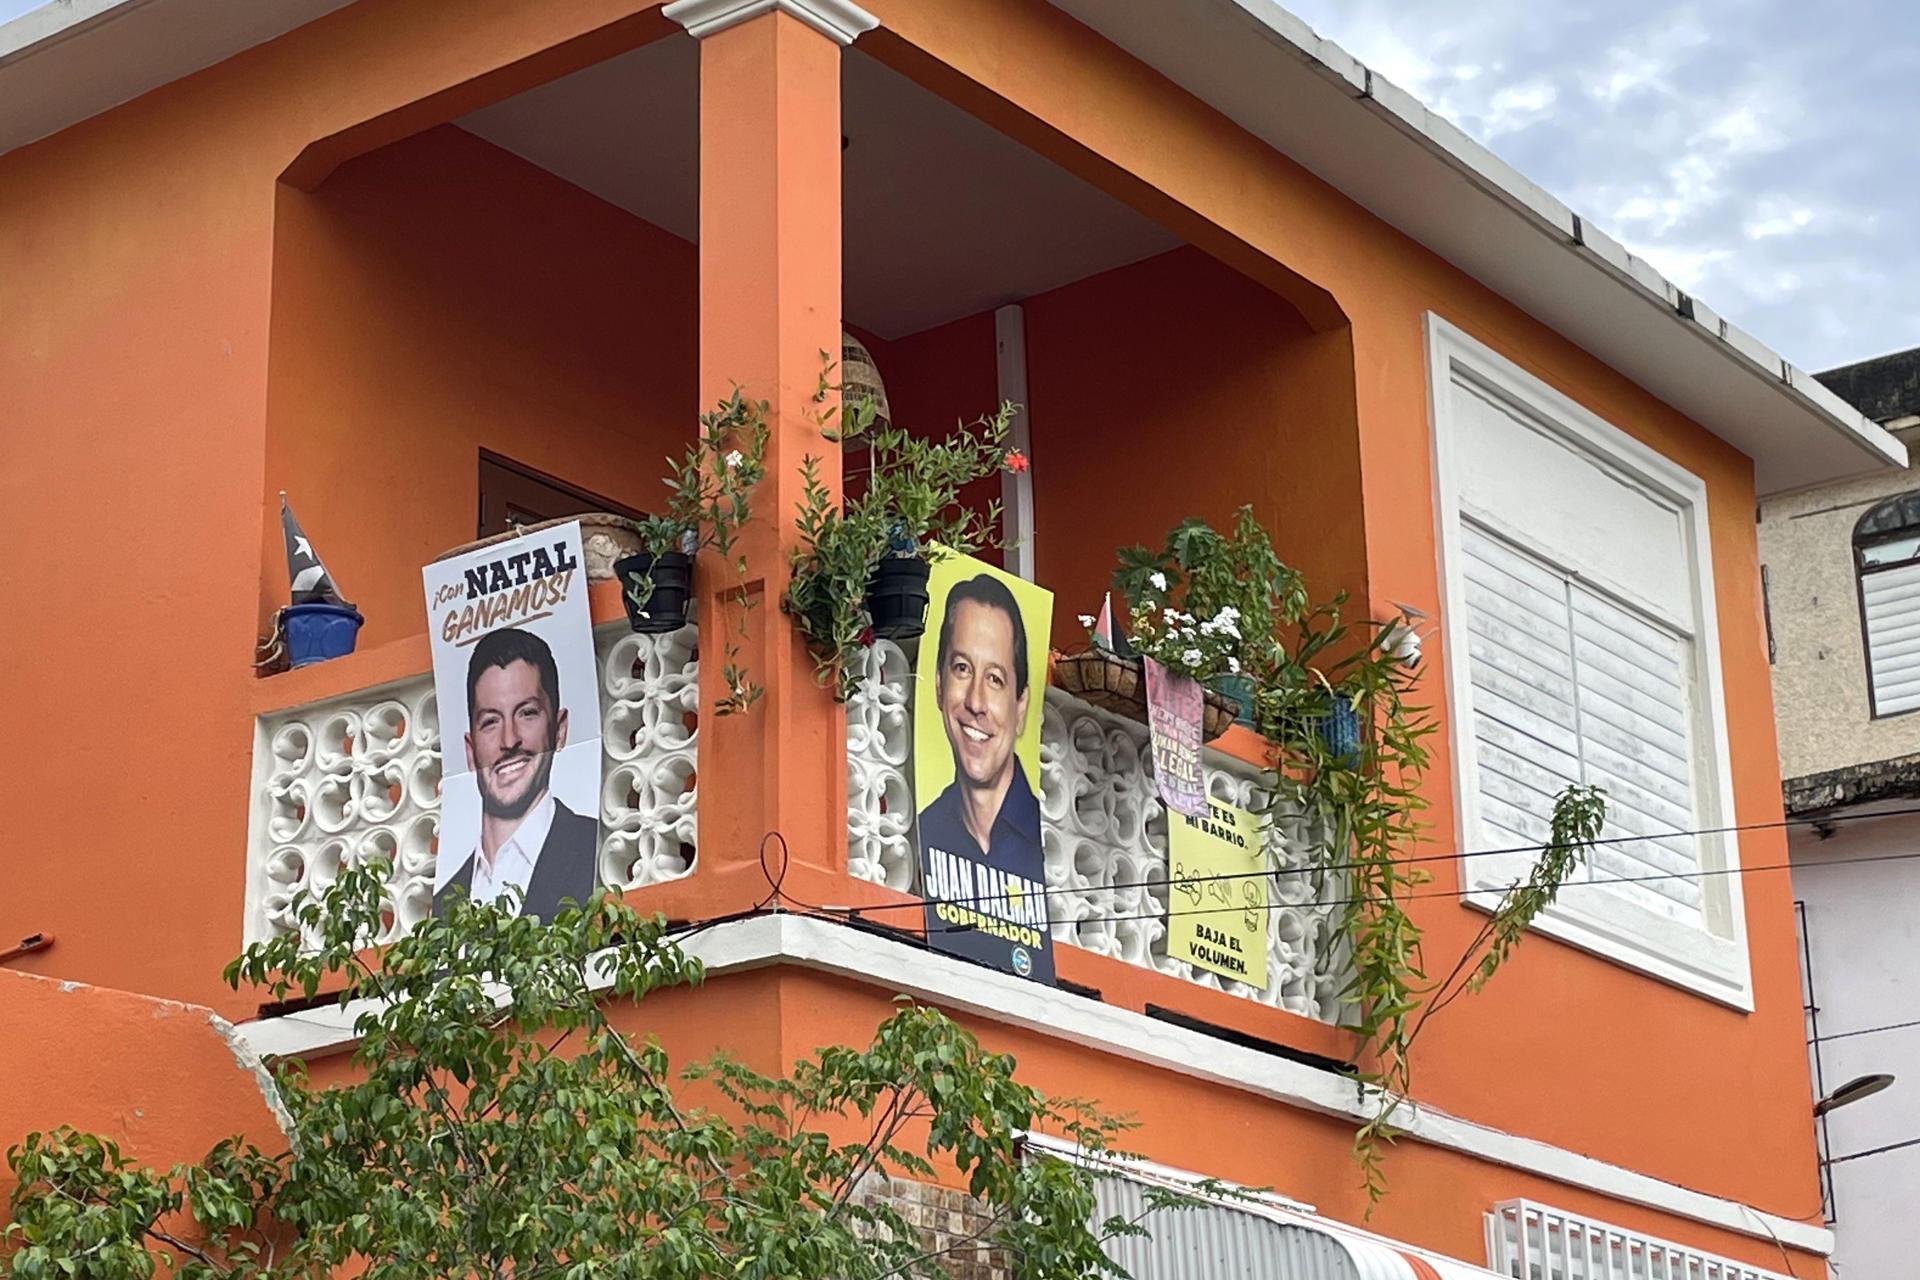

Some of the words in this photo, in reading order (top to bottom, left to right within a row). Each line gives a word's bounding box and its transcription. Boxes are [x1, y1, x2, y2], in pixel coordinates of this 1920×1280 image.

[464, 541, 577, 600] NATAL
[442, 569, 573, 642] GANAMOS!
[1185, 815, 1199, 829] MI
[1201, 819, 1249, 850] BARRIO.
[1221, 808, 1236, 826] ES
[926, 847, 975, 911] JUAN
[976, 863, 1048, 932] DALMAU
[936, 902, 1043, 950] GOBERNADOR
[1195, 923, 1227, 948] BAJA
[1229, 937, 1243, 953] EL
[1189, 941, 1248, 975] VOLUMEN.
